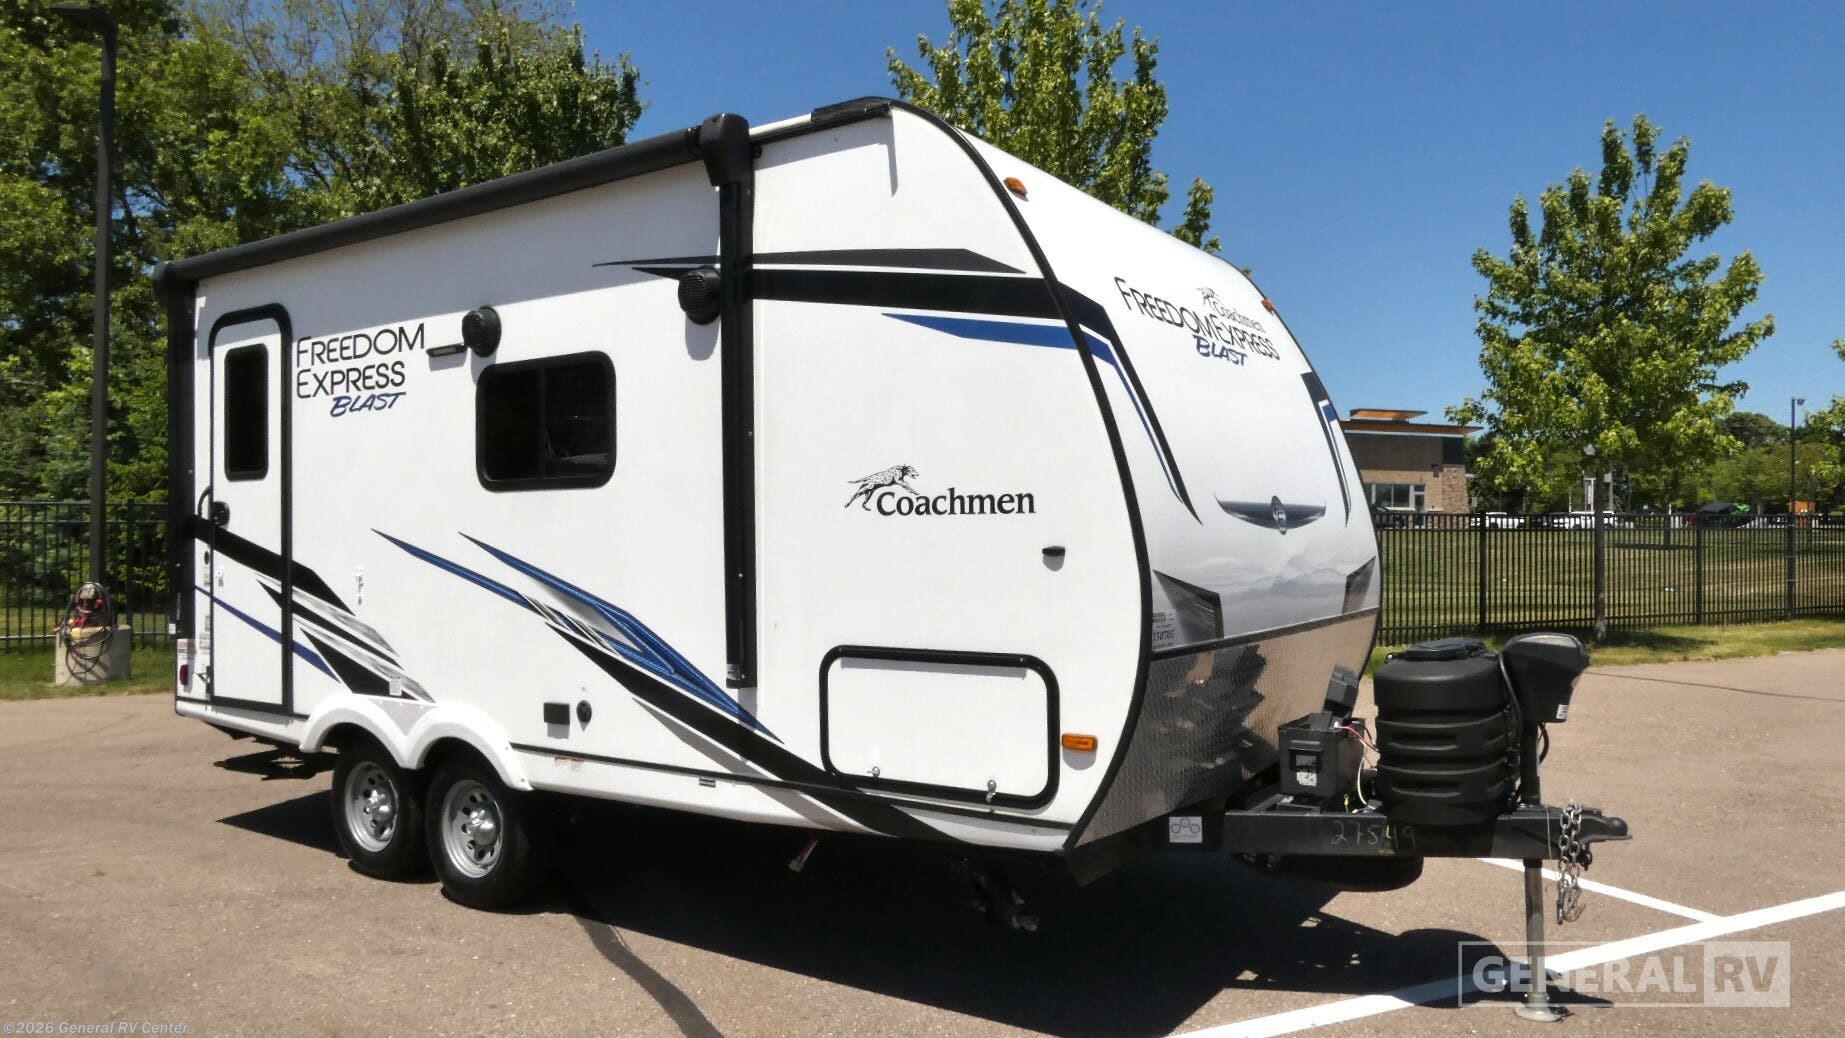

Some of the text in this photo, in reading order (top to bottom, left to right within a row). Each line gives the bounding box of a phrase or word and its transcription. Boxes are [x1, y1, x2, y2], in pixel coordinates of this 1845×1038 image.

[1114, 276, 1281, 361] FREEDOM EXPRESS
[296, 322, 425, 369] FREEDOM
[1192, 333, 1249, 366] BLAST
[296, 360, 406, 399] EXPRESS
[330, 391, 407, 418] BLAST
[876, 487, 1037, 517] Coachmen
